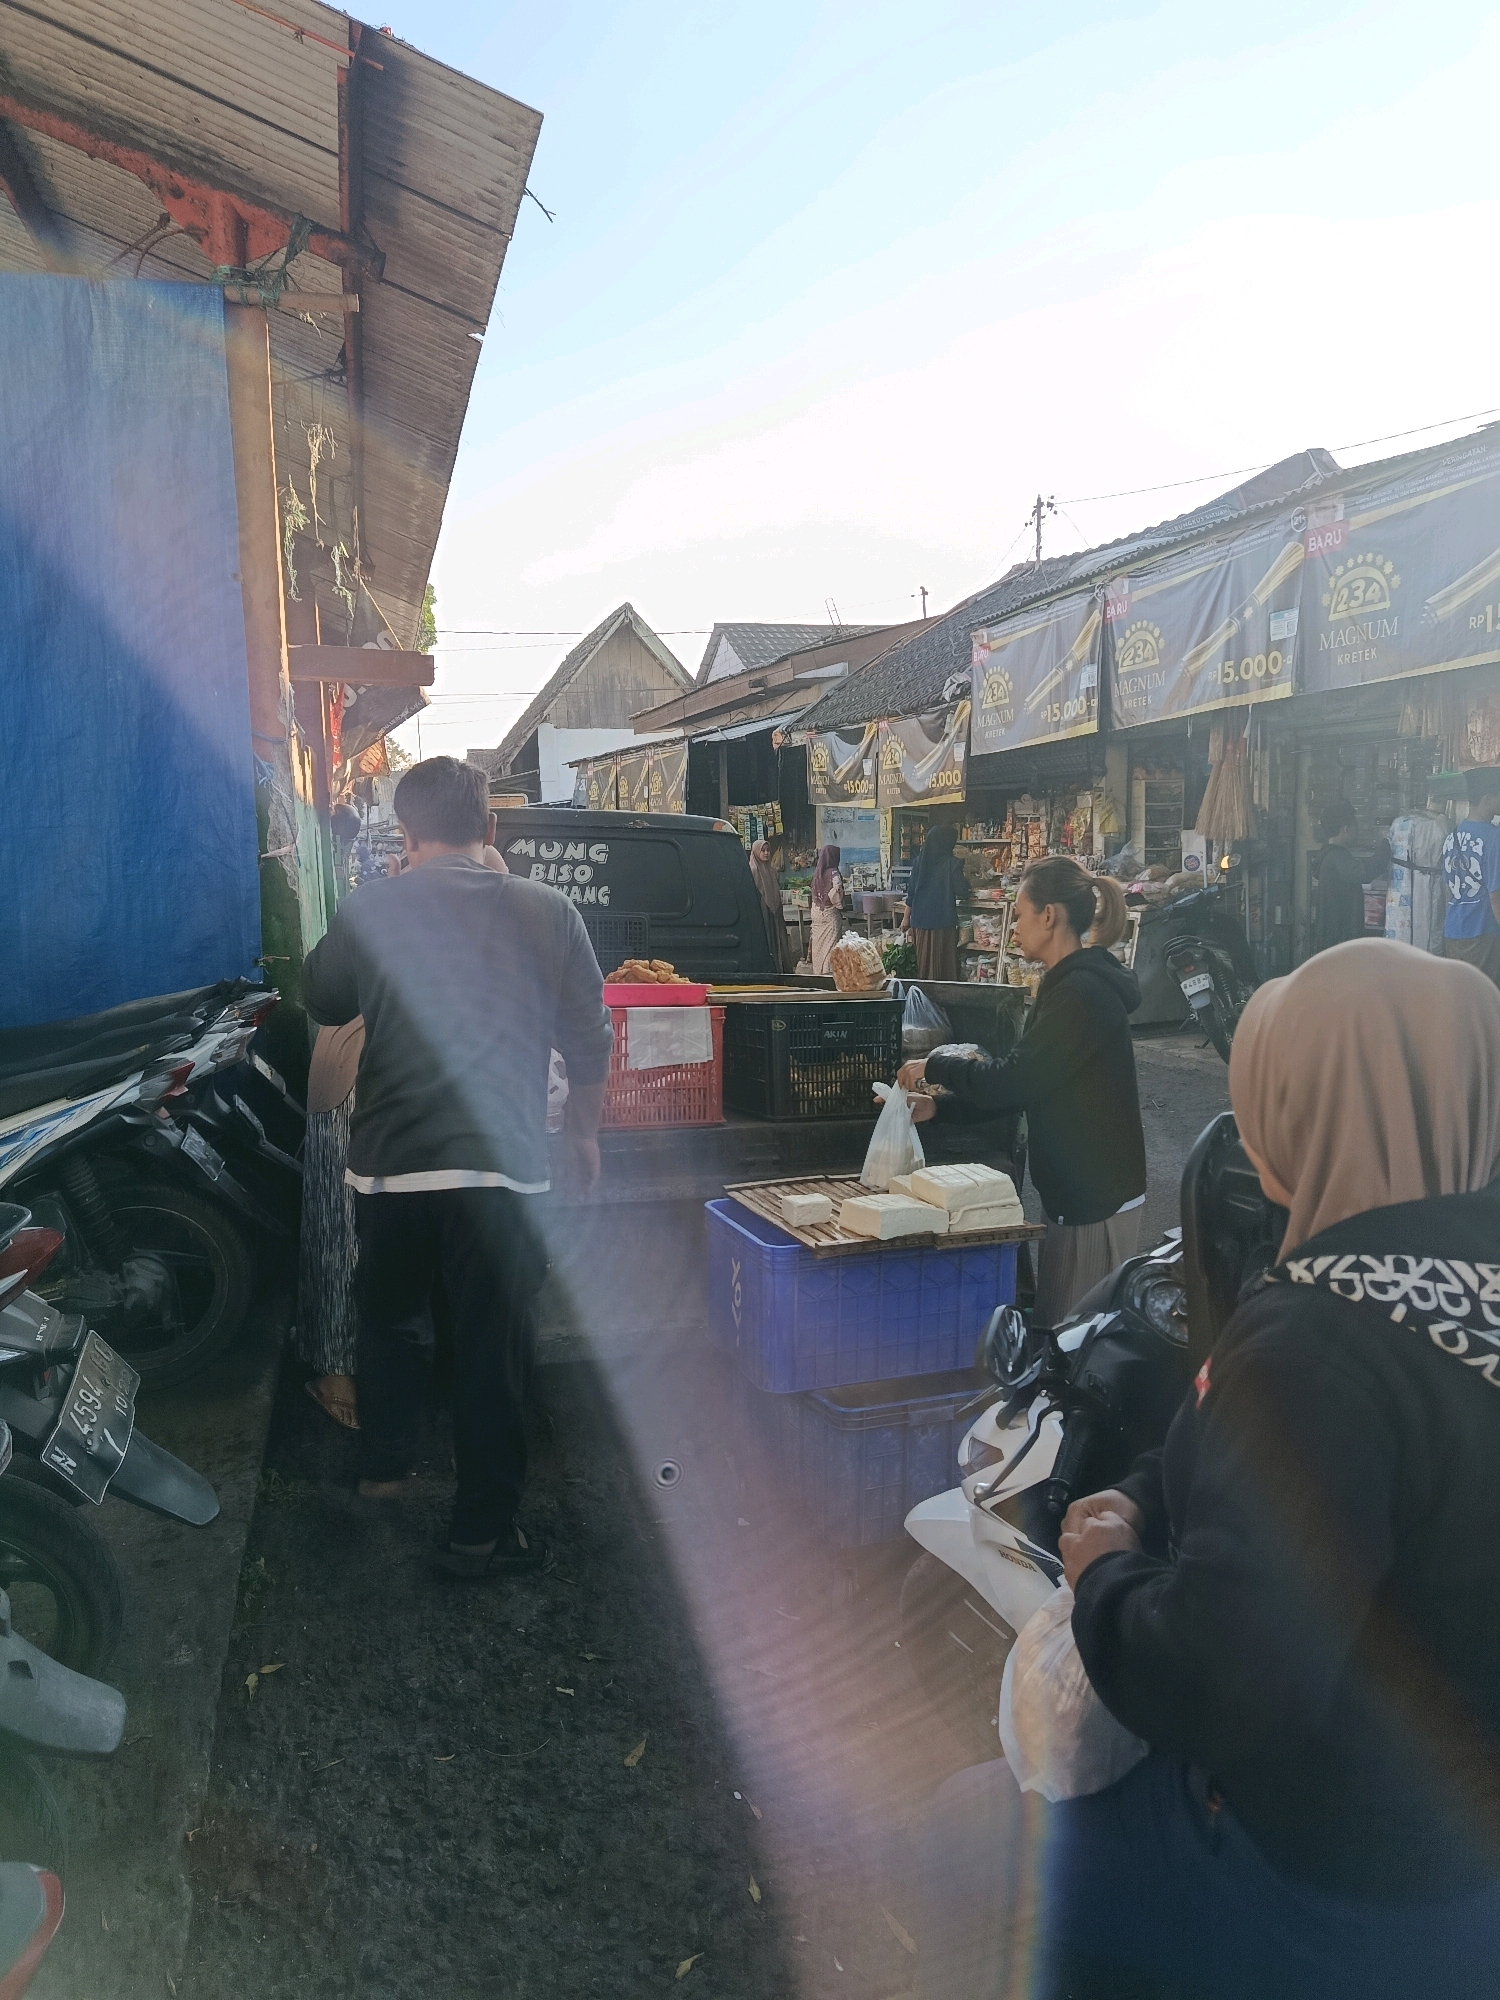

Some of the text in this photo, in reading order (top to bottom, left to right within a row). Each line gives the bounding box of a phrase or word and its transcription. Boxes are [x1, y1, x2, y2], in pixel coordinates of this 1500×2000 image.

[1308, 529, 1342, 552] BARU
[1337, 578, 1382, 612] 234
[1106, 602, 1128, 618] BARU
[1319, 616, 1399, 651] MAGNUM
[1122, 640, 1154, 667] 234
[1337, 647, 1378, 665] KRETEK
[986, 682, 1005, 703] 234
[1114, 671, 1166, 698] MAGNUM
[1123, 694, 1152, 709] KRETEK
[977, 708, 1014, 729] MAGNUM
[507, 838, 609, 864] MUNG
[528, 863, 594, 885] BISO
[70, 1374, 104, 1436] 4594
[998, 1549, 1037, 1572] HONDA
